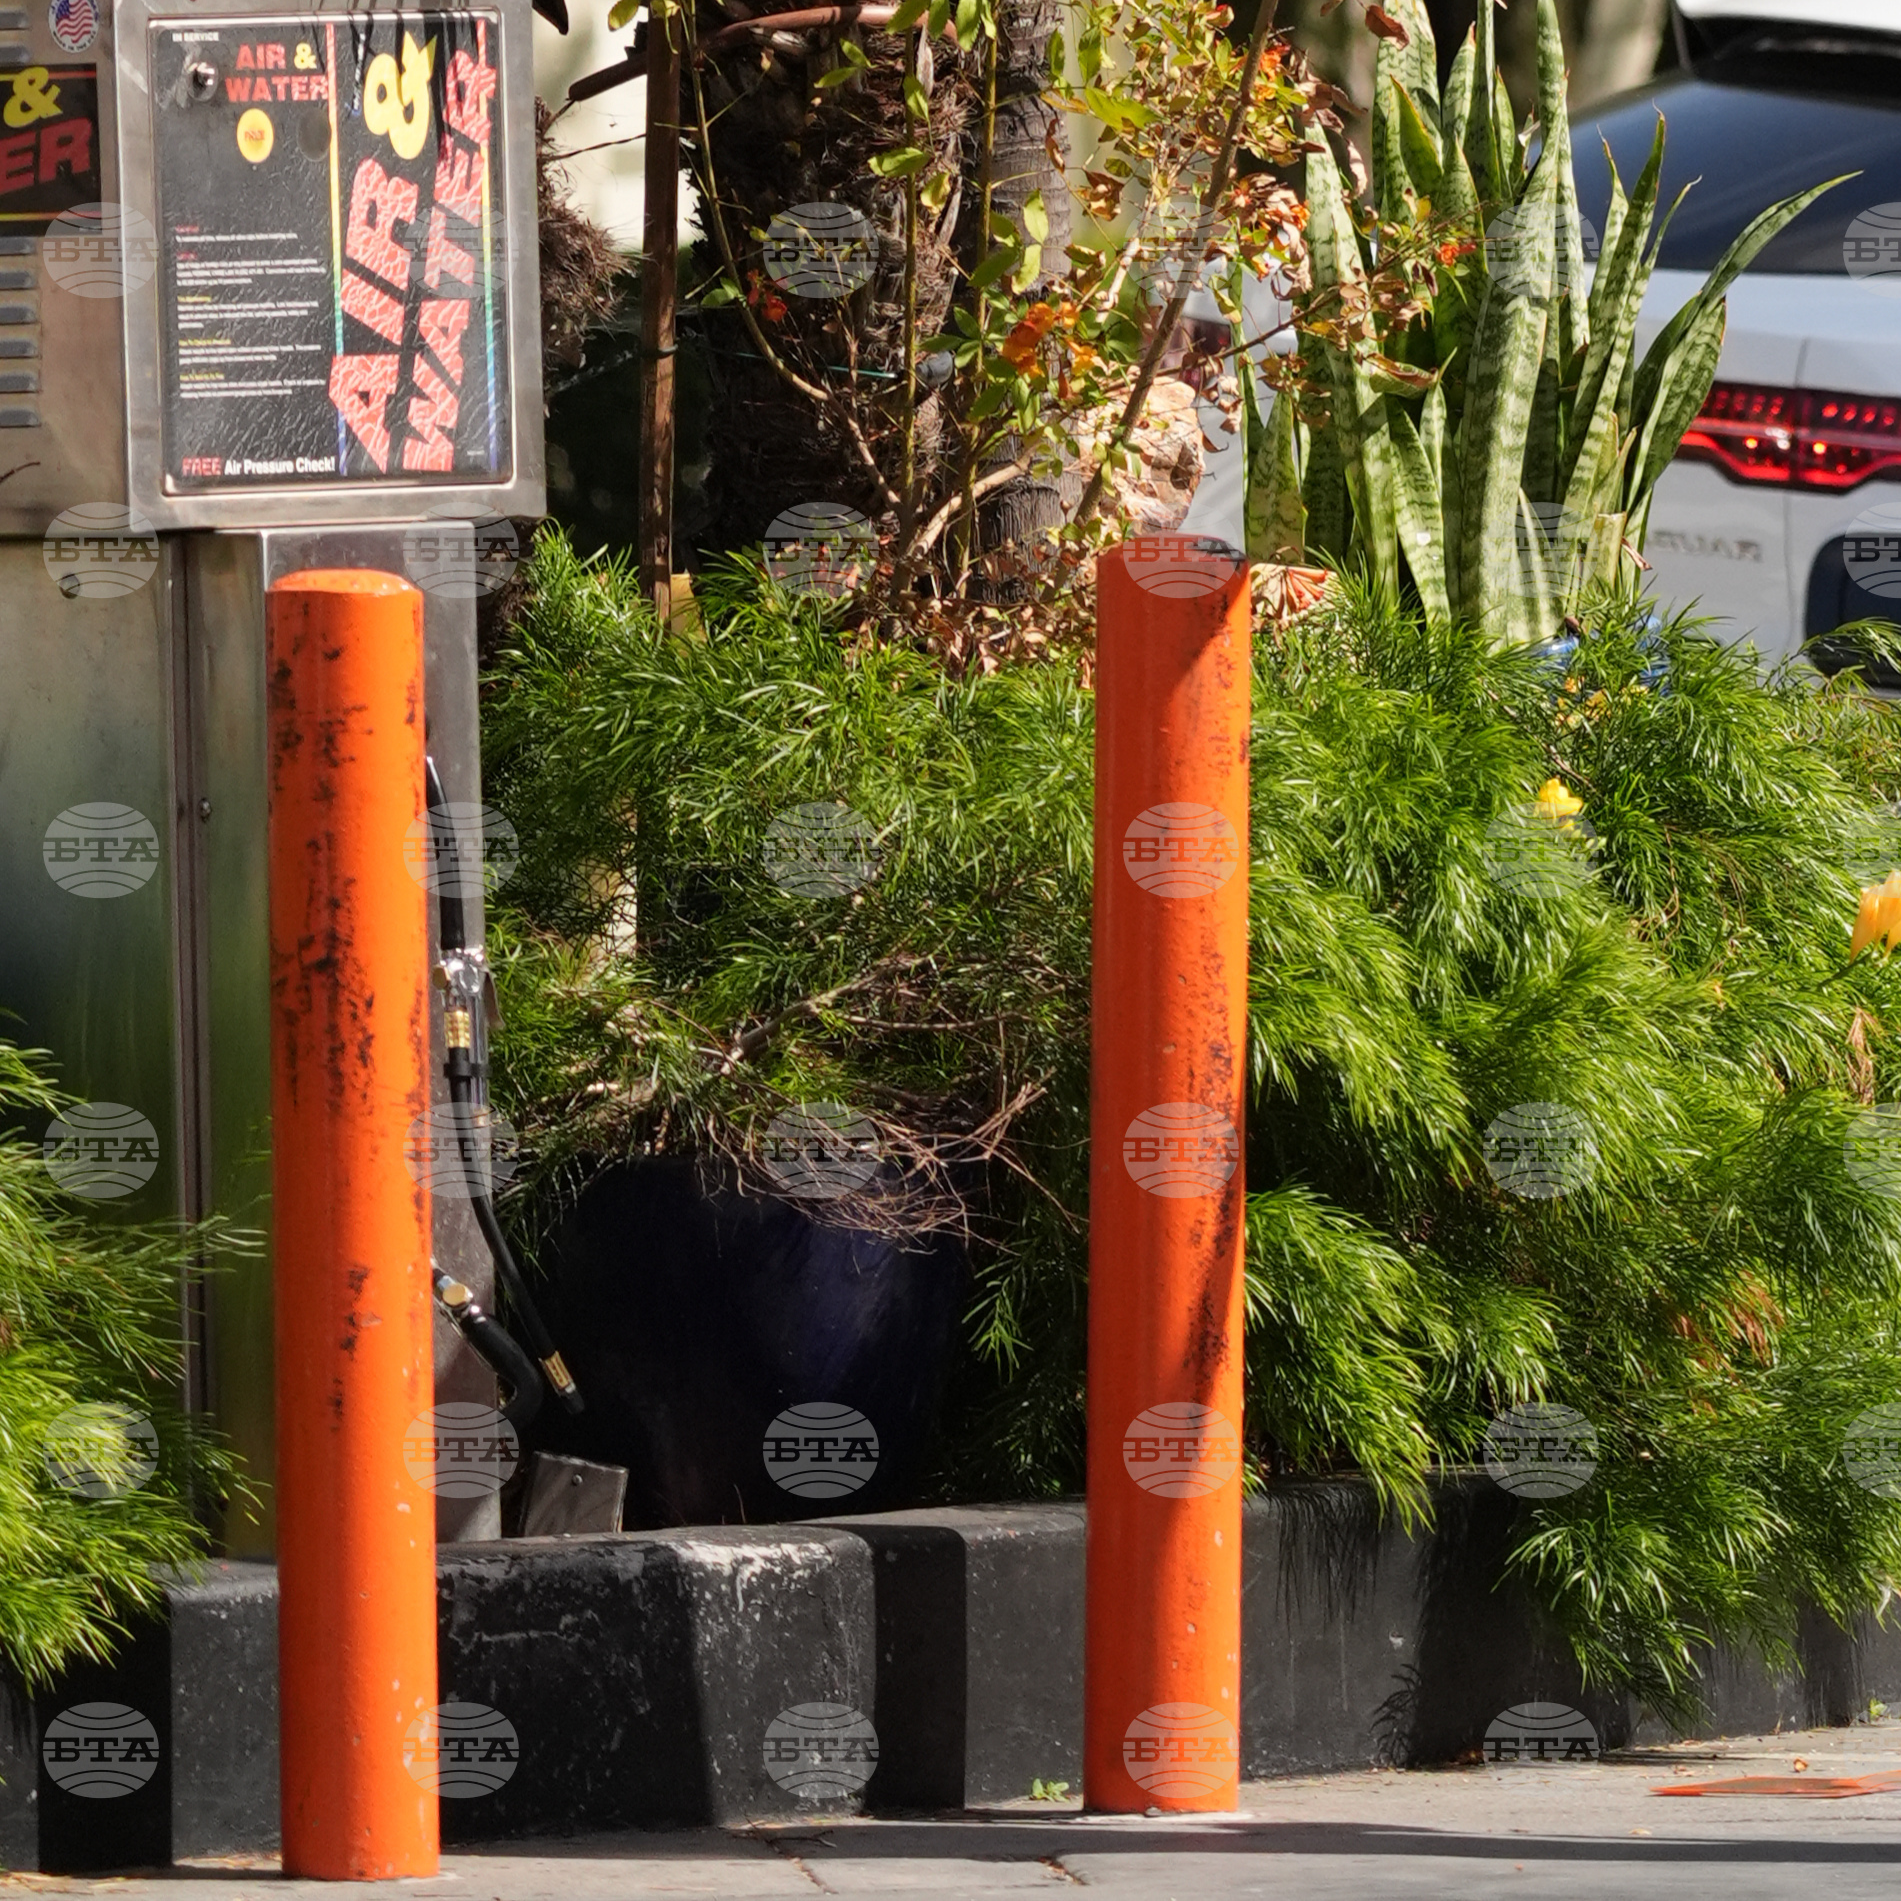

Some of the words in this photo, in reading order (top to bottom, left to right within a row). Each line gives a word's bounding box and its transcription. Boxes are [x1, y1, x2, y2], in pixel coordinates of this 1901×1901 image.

[235, 43, 286, 70] AIR
[293, 42, 318, 70] &
[3, 66, 63, 128] &
[225, 74, 330, 103] WATER
[363, 30, 437, 160] &
[402, 49, 497, 473] WATER
[329, 158, 420, 475] AIR
[182, 457, 222, 477] FREE
[223, 459, 242, 476] Air
[243, 457, 294, 475] Pressure
[295, 455, 336, 473] Check!
